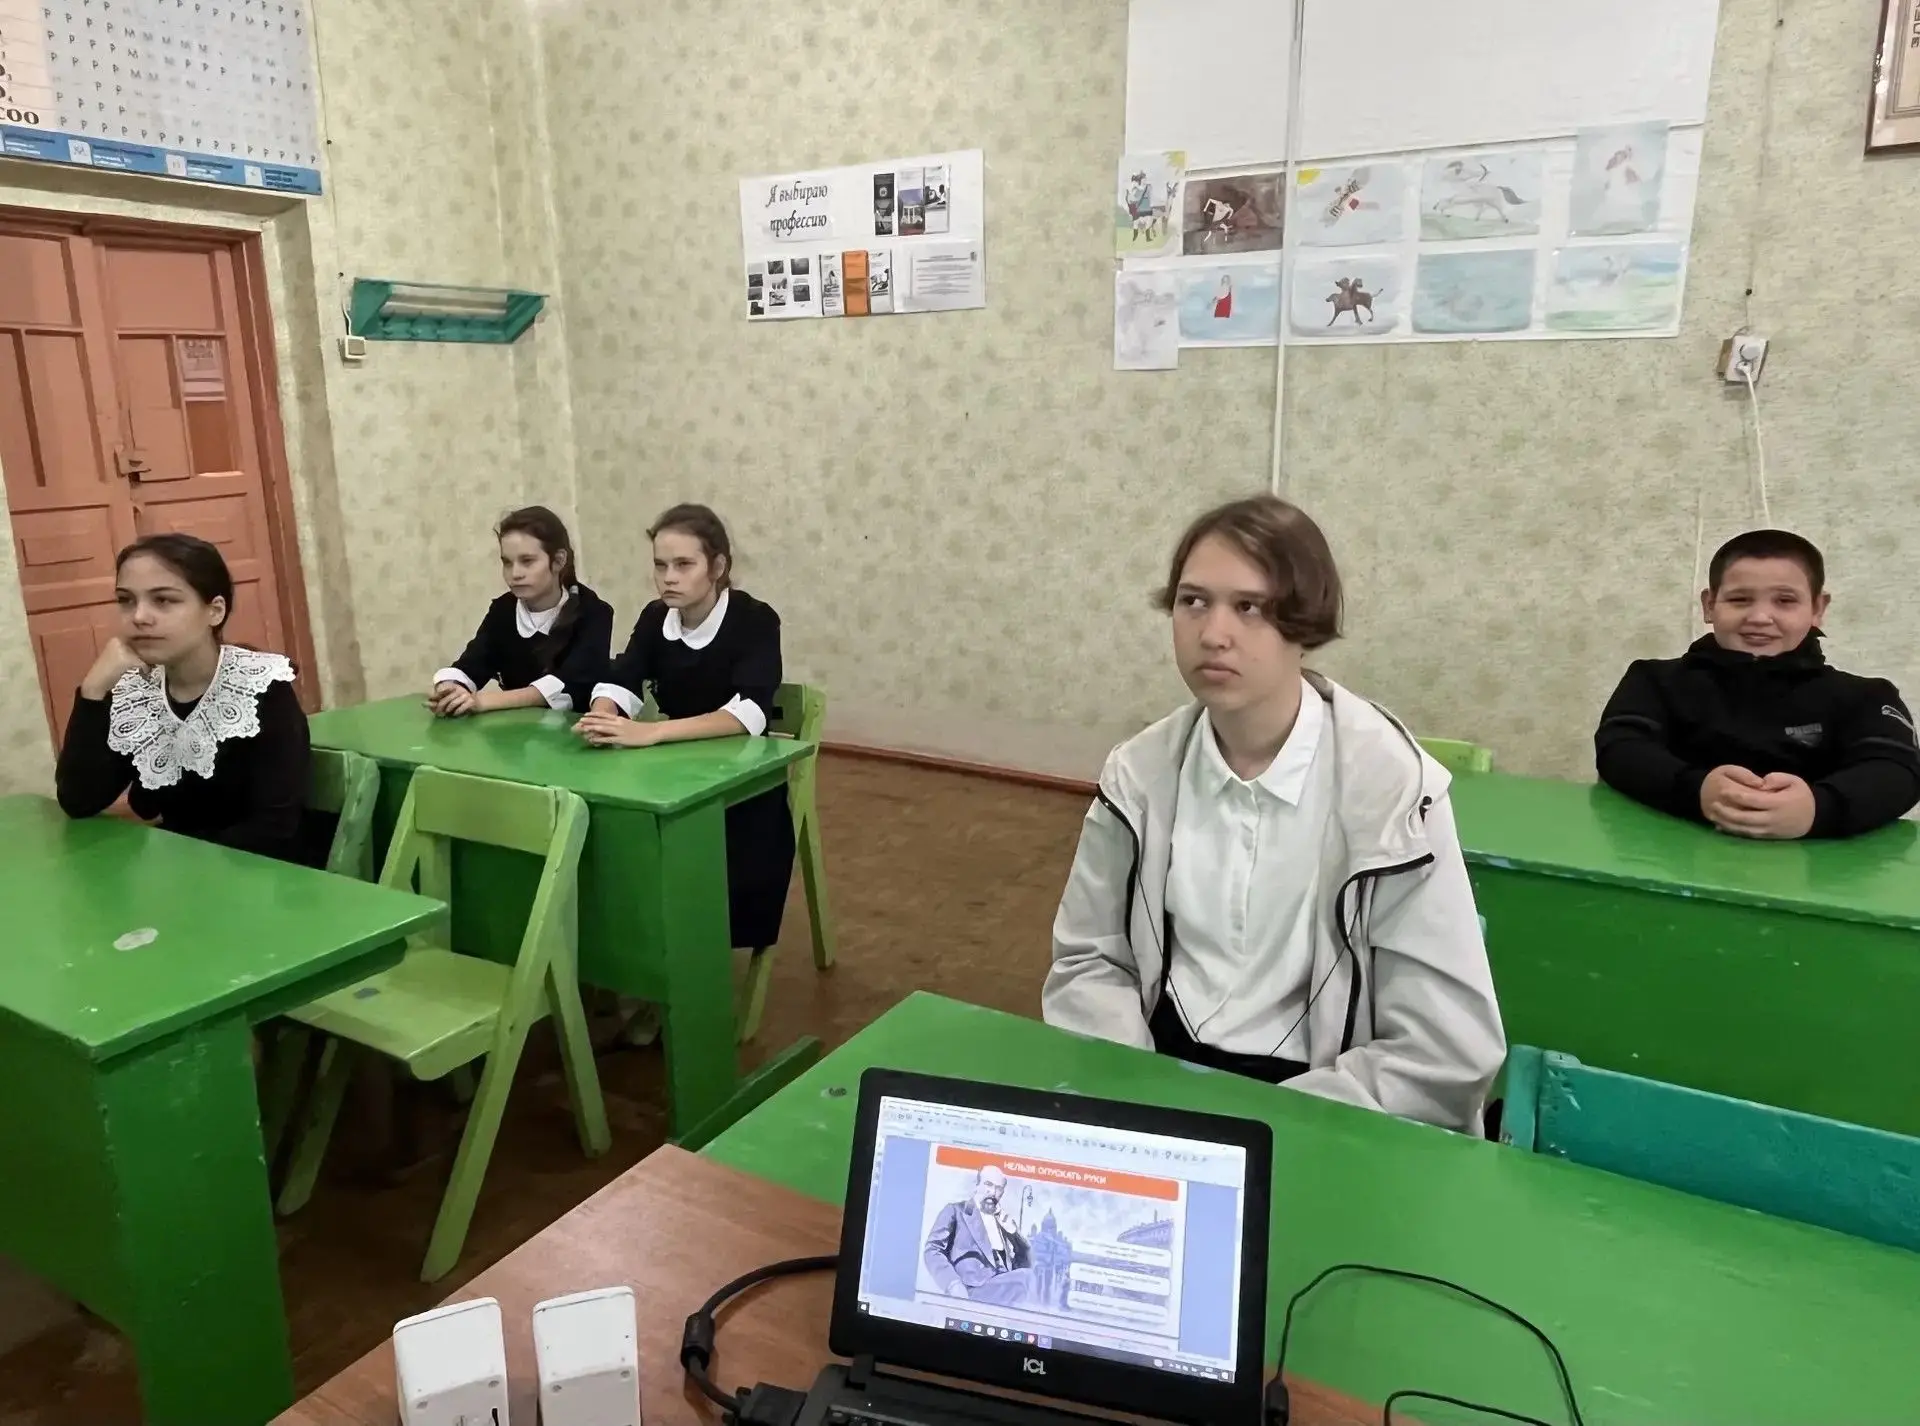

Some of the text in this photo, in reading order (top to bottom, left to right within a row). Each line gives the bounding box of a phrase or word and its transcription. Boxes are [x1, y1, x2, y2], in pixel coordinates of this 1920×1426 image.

[765, 180, 828, 208] Я выбираю
[770, 209, 827, 238] профессию
[1003, 1161, 1107, 1184] НЕЛЬЗЯ ОПУСКАТЬ РУКИ
[1023, 1357, 1047, 1375] ICL
